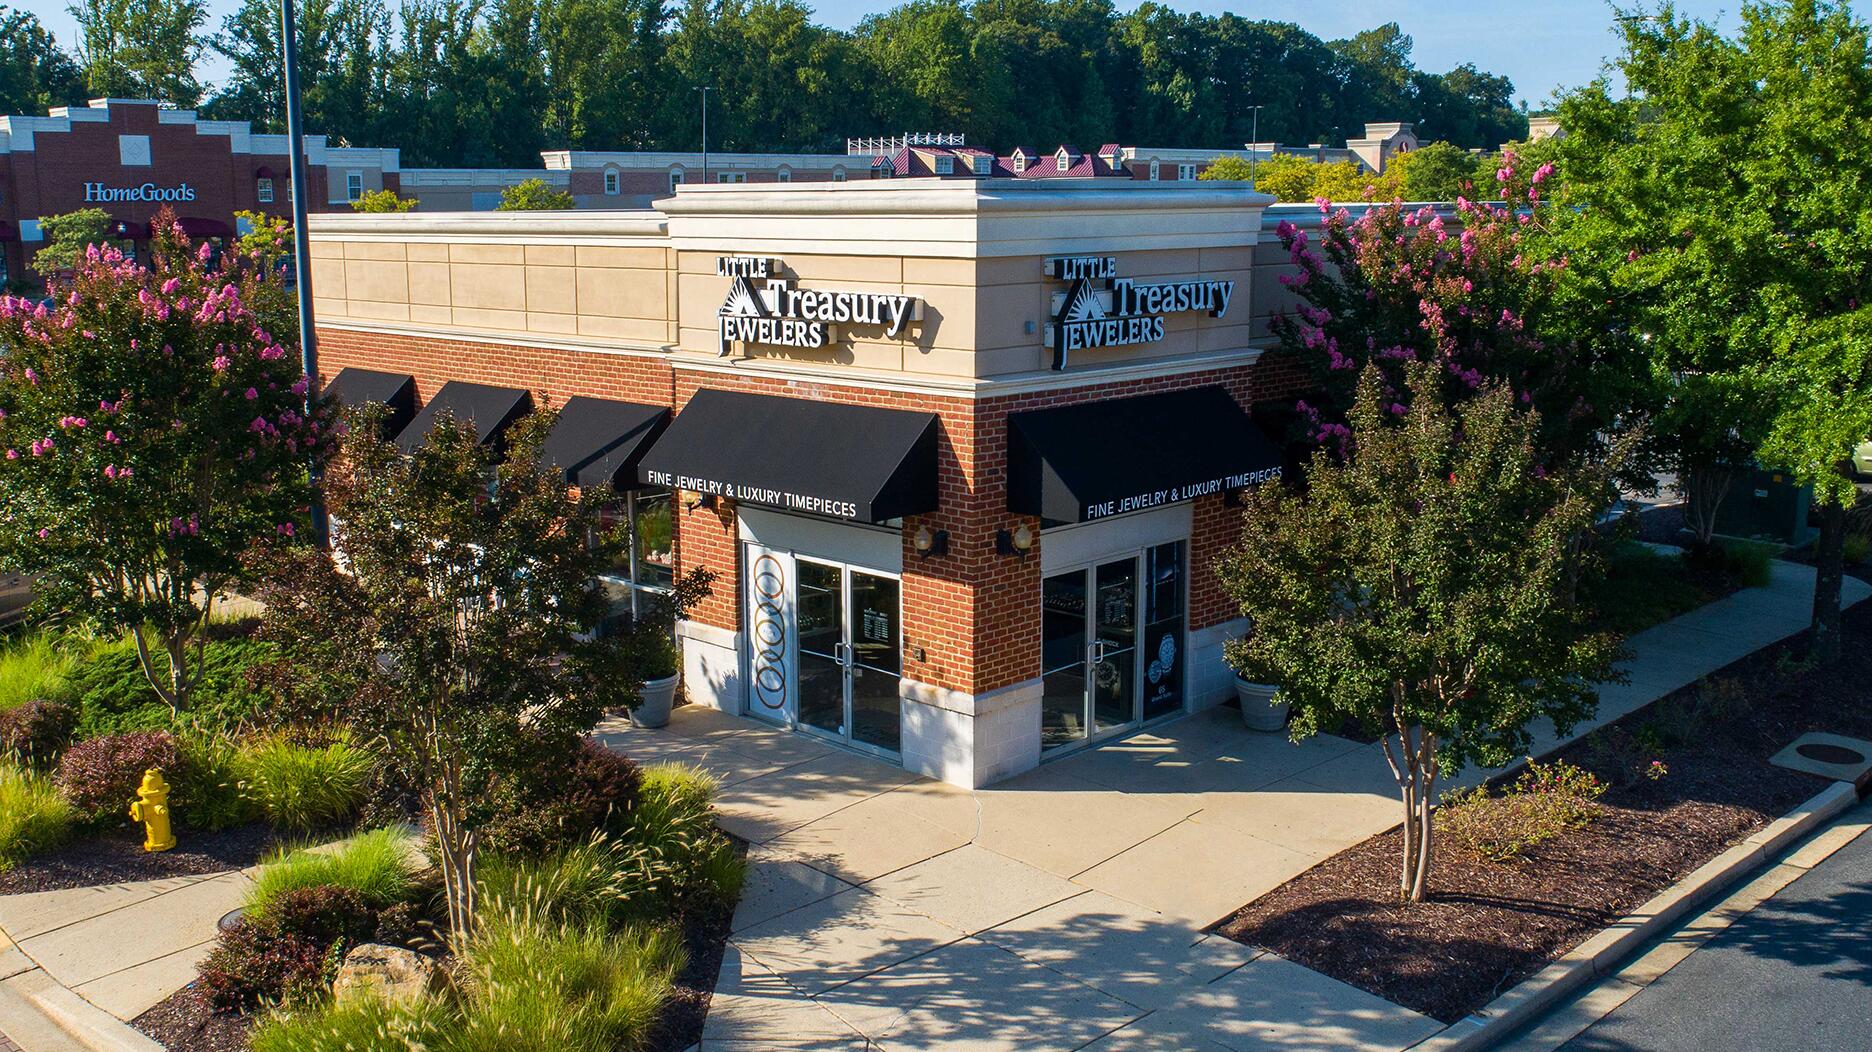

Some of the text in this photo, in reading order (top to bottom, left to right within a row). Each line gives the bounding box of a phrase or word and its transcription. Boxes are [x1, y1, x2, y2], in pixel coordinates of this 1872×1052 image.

[83, 182, 196, 202] HomeGoods
[716, 256, 768, 279] LITTLE
[1062, 256, 1117, 280] LITTLE
[766, 278, 909, 337] Treasury
[1114, 277, 1236, 319] Treasury
[717, 315, 823, 358] JEWELERS
[1060, 315, 1165, 371] JEWELERS
[648, 470, 857, 518] FINE JEWELRY & LUXURY TIMEPIECES
[1087, 466, 1282, 520] FINE JEWELRY & LUXURY TIMEPIECES
